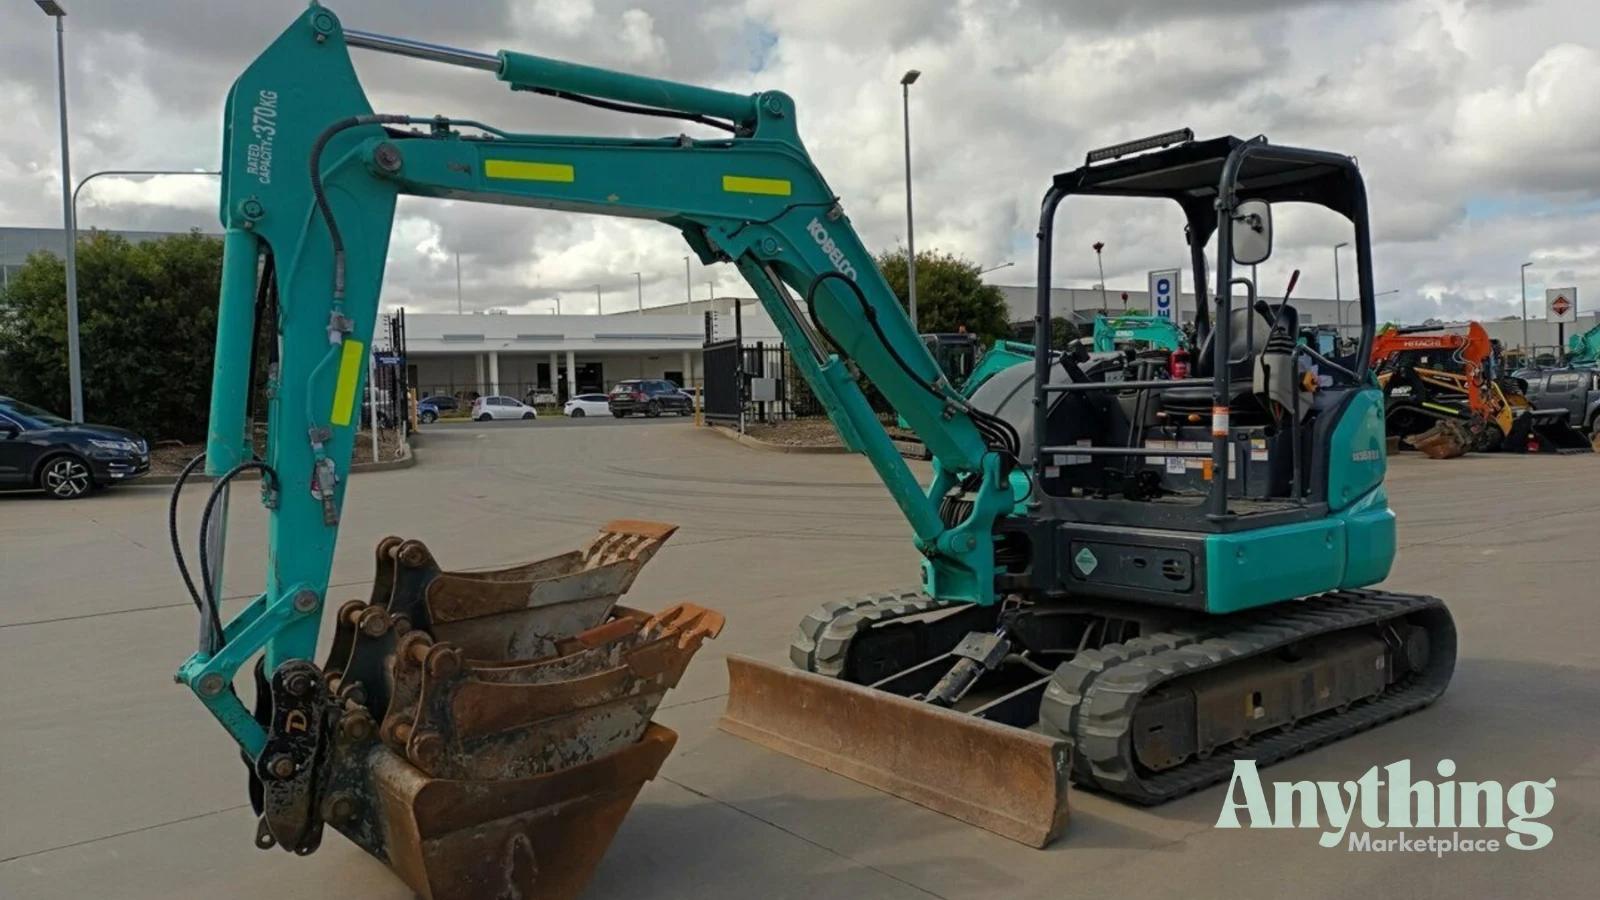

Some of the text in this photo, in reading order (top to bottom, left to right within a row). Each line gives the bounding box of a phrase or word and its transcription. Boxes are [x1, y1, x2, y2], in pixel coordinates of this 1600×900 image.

[247, 144, 260, 175] RATED
[259, 140, 273, 184] CAPACITY
[807, 217, 857, 281] KOBELCO
